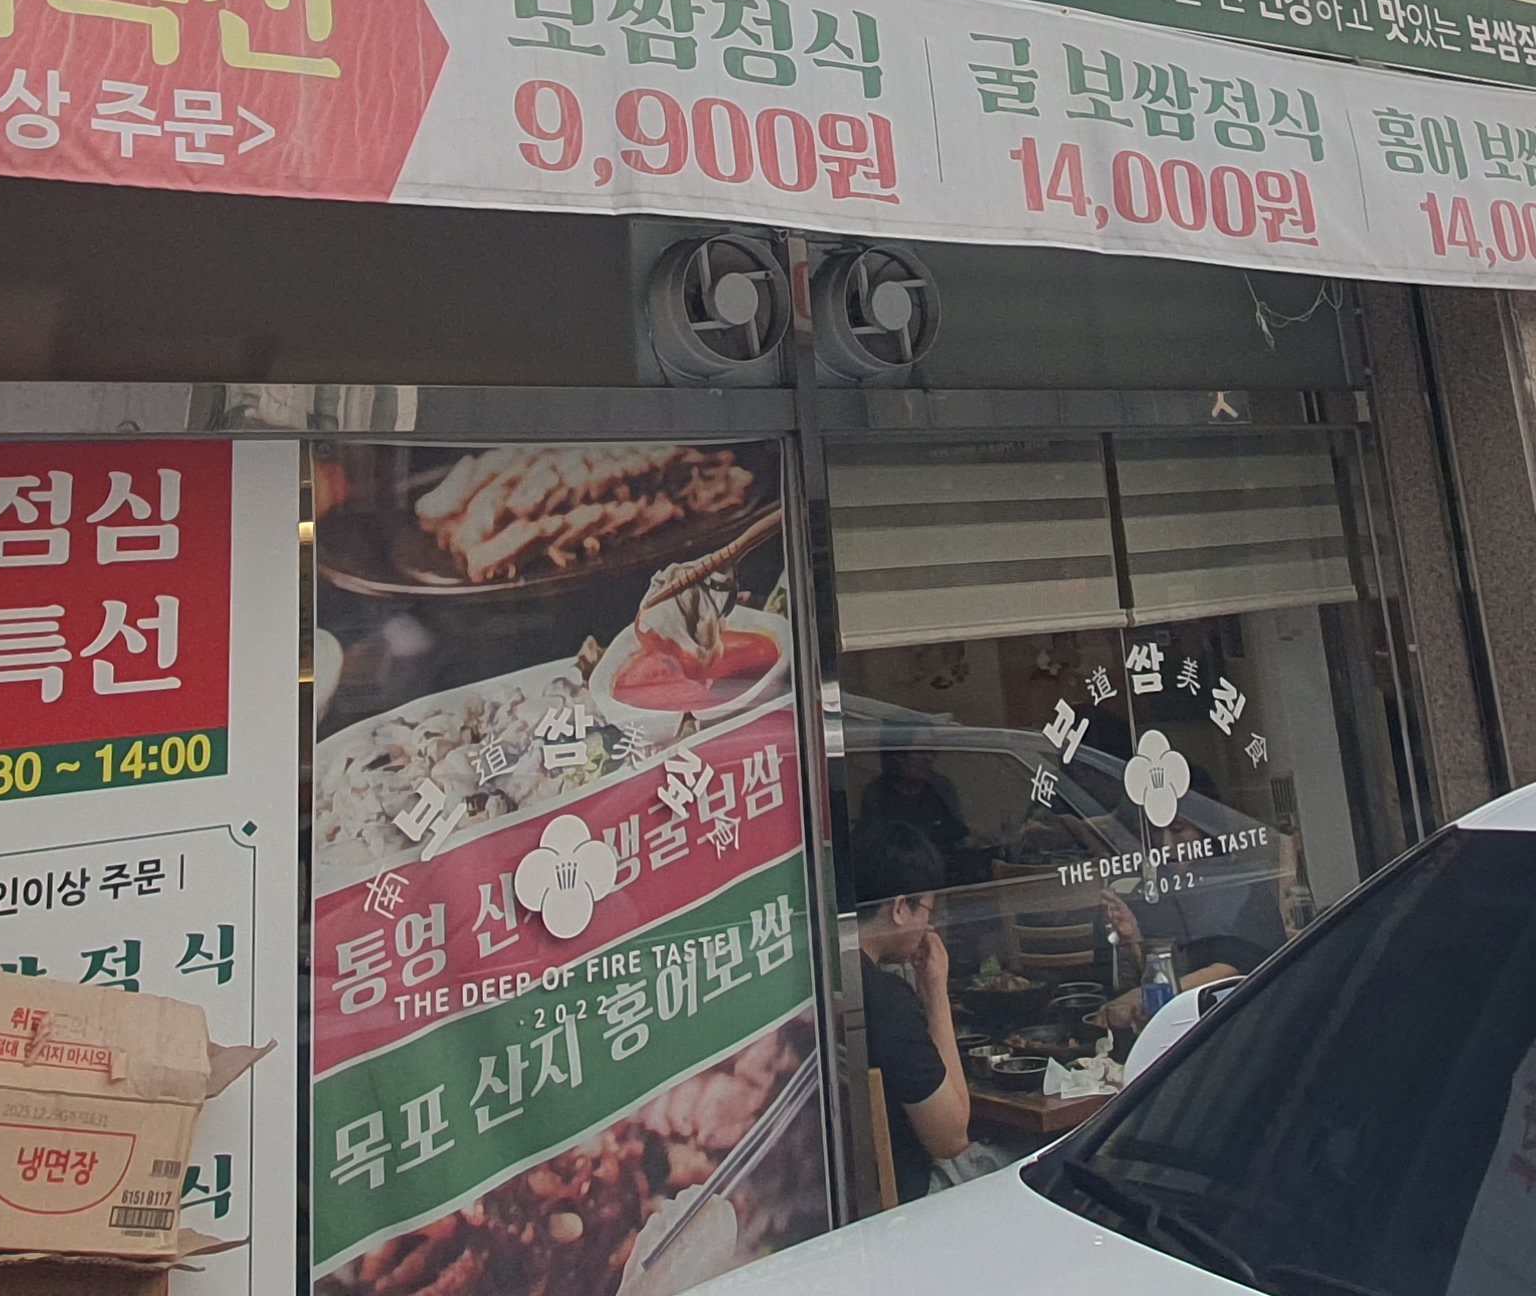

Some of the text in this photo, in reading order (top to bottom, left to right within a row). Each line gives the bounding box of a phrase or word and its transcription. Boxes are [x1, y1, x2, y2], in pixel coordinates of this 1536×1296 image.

[513, 79, 901, 205] 9,900원
[966, 32, 1327, 164] 굴 보쌈정식
[1372, 106, 1467, 180] 홍어
[1010, 136, 1320, 249] 14,000원
[95, 732, 212, 784] 14:00
[99, 857, 167, 904] 주문
[1057, 827, 1269, 888] THE DEEP OF FIRE TASTE
[331, 903, 448, 1015] 통영
[394, 933, 730, 1021] THE DEEP OF FIRE TASTE
[330, 893, 796, 1190] 목포 산지 홍어보쌈
[17, 1146, 99, 1187] 냉면장
